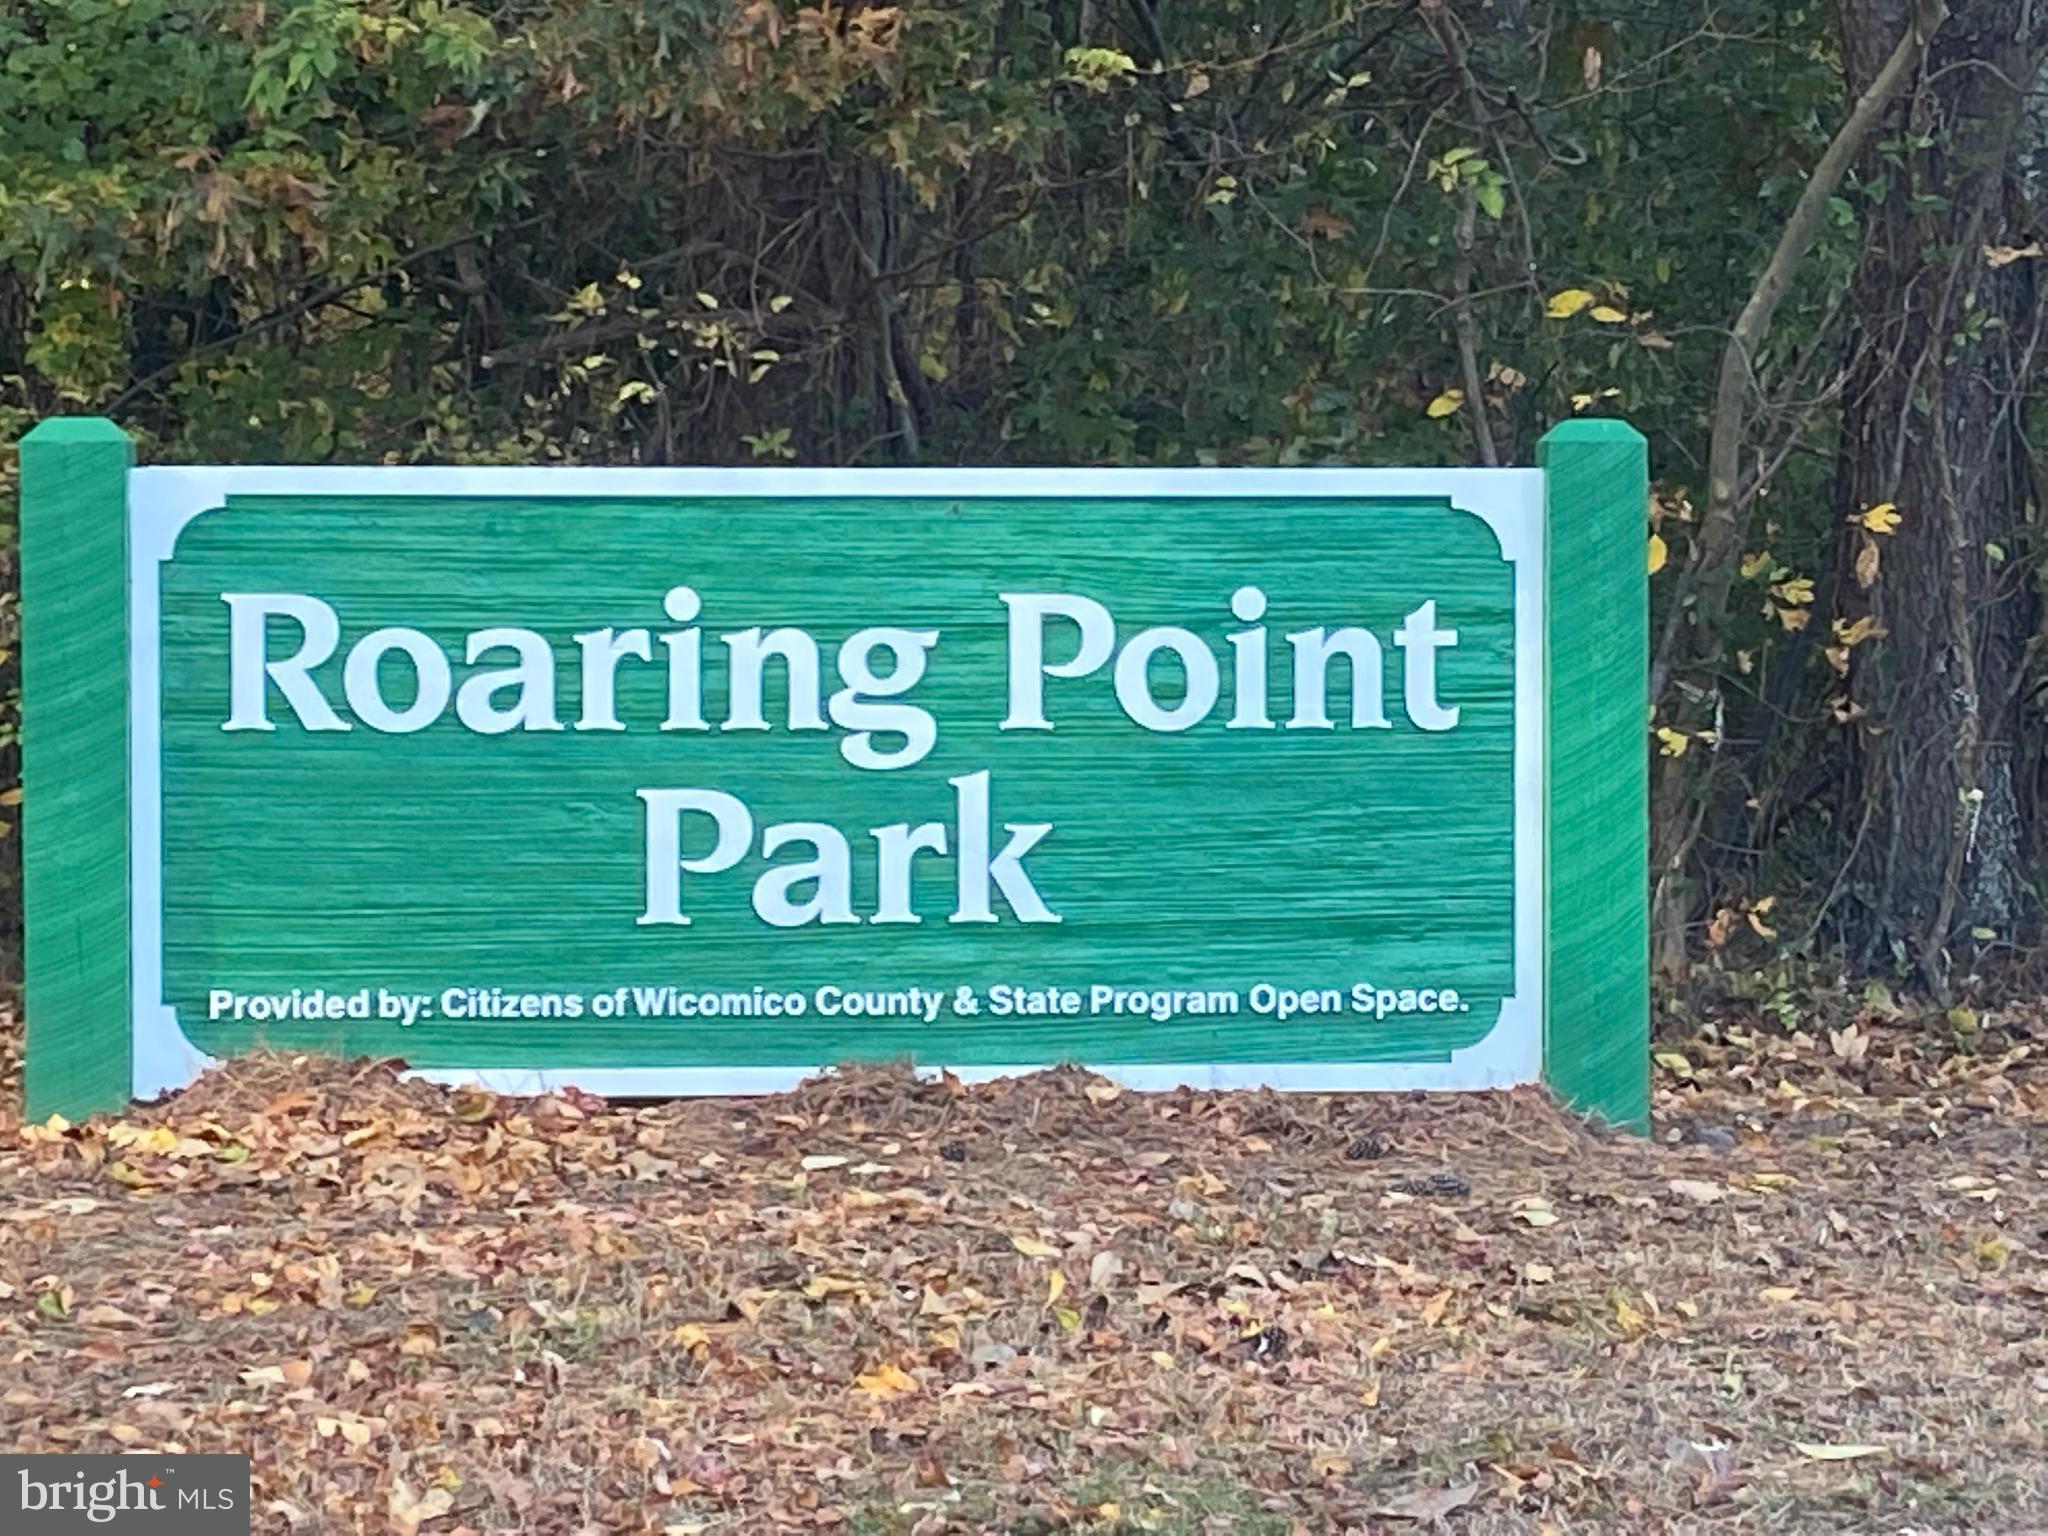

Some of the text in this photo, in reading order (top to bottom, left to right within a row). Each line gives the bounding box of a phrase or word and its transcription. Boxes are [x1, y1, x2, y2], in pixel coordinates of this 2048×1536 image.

[220, 586, 1460, 771] Roaring Point
[636, 768, 1062, 928] Park
[209, 983, 1469, 1026] Provided by: Citizens of Wicomico County & State Program Open Space.
